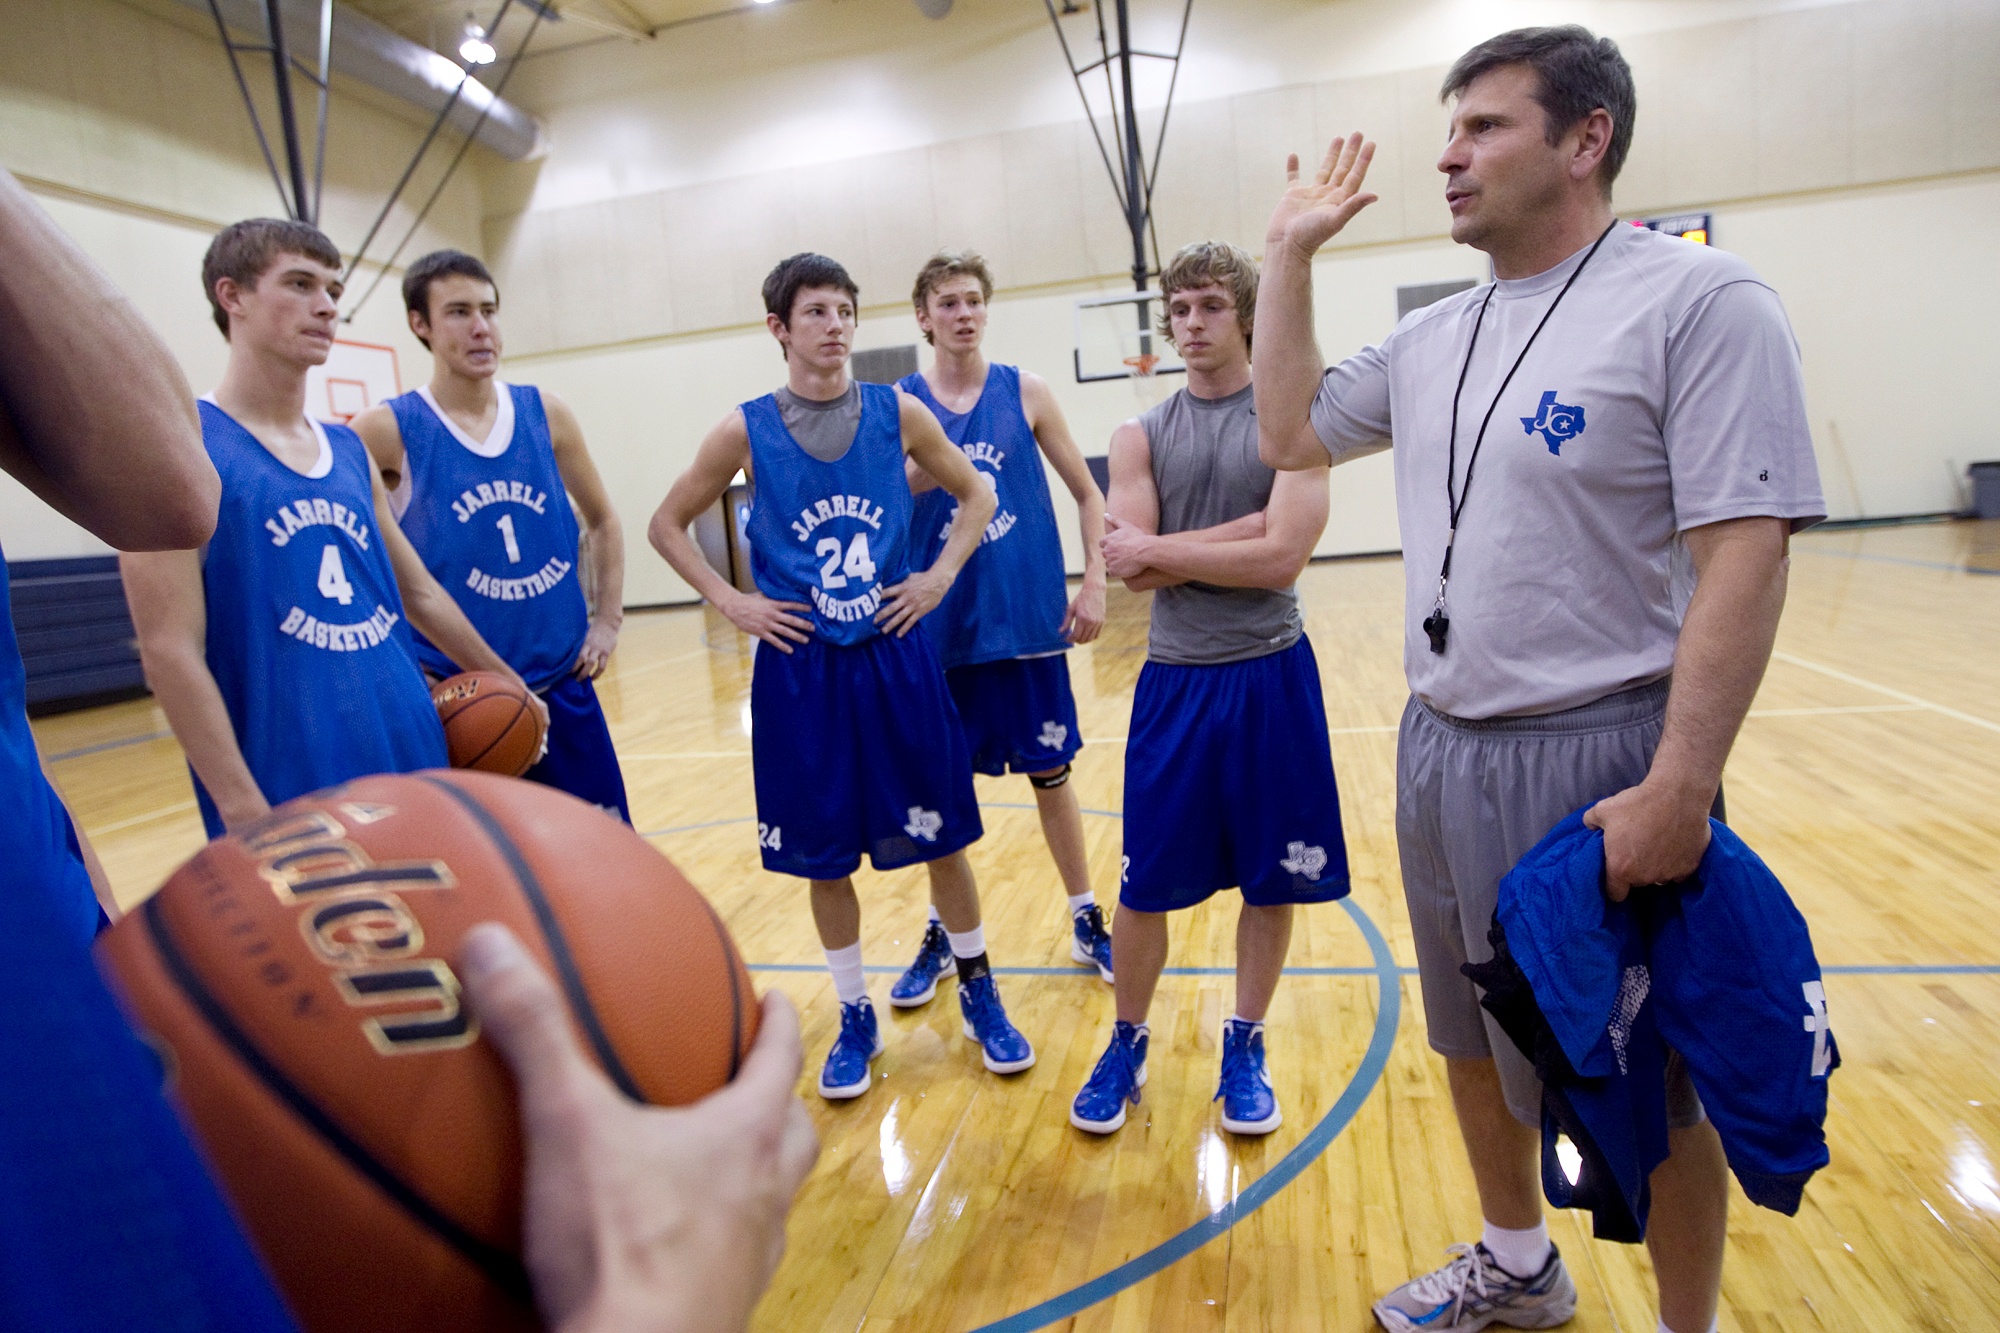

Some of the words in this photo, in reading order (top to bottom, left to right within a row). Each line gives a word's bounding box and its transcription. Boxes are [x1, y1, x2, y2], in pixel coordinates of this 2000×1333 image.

[1533, 404, 1575, 437] JC
[265, 498, 370, 552] JARRELL
[451, 480, 547, 524] JARRELL
[791, 494, 884, 542] JARRELL
[496, 514, 521, 563] 1
[815, 532, 877, 590] 24
[317, 544, 355, 606] 4
[466, 555, 572, 601] BASKETBALL
[279, 603, 400, 652] BASKETBALL
[758, 822, 783, 852] 24
[238, 803, 482, 1058] aden
